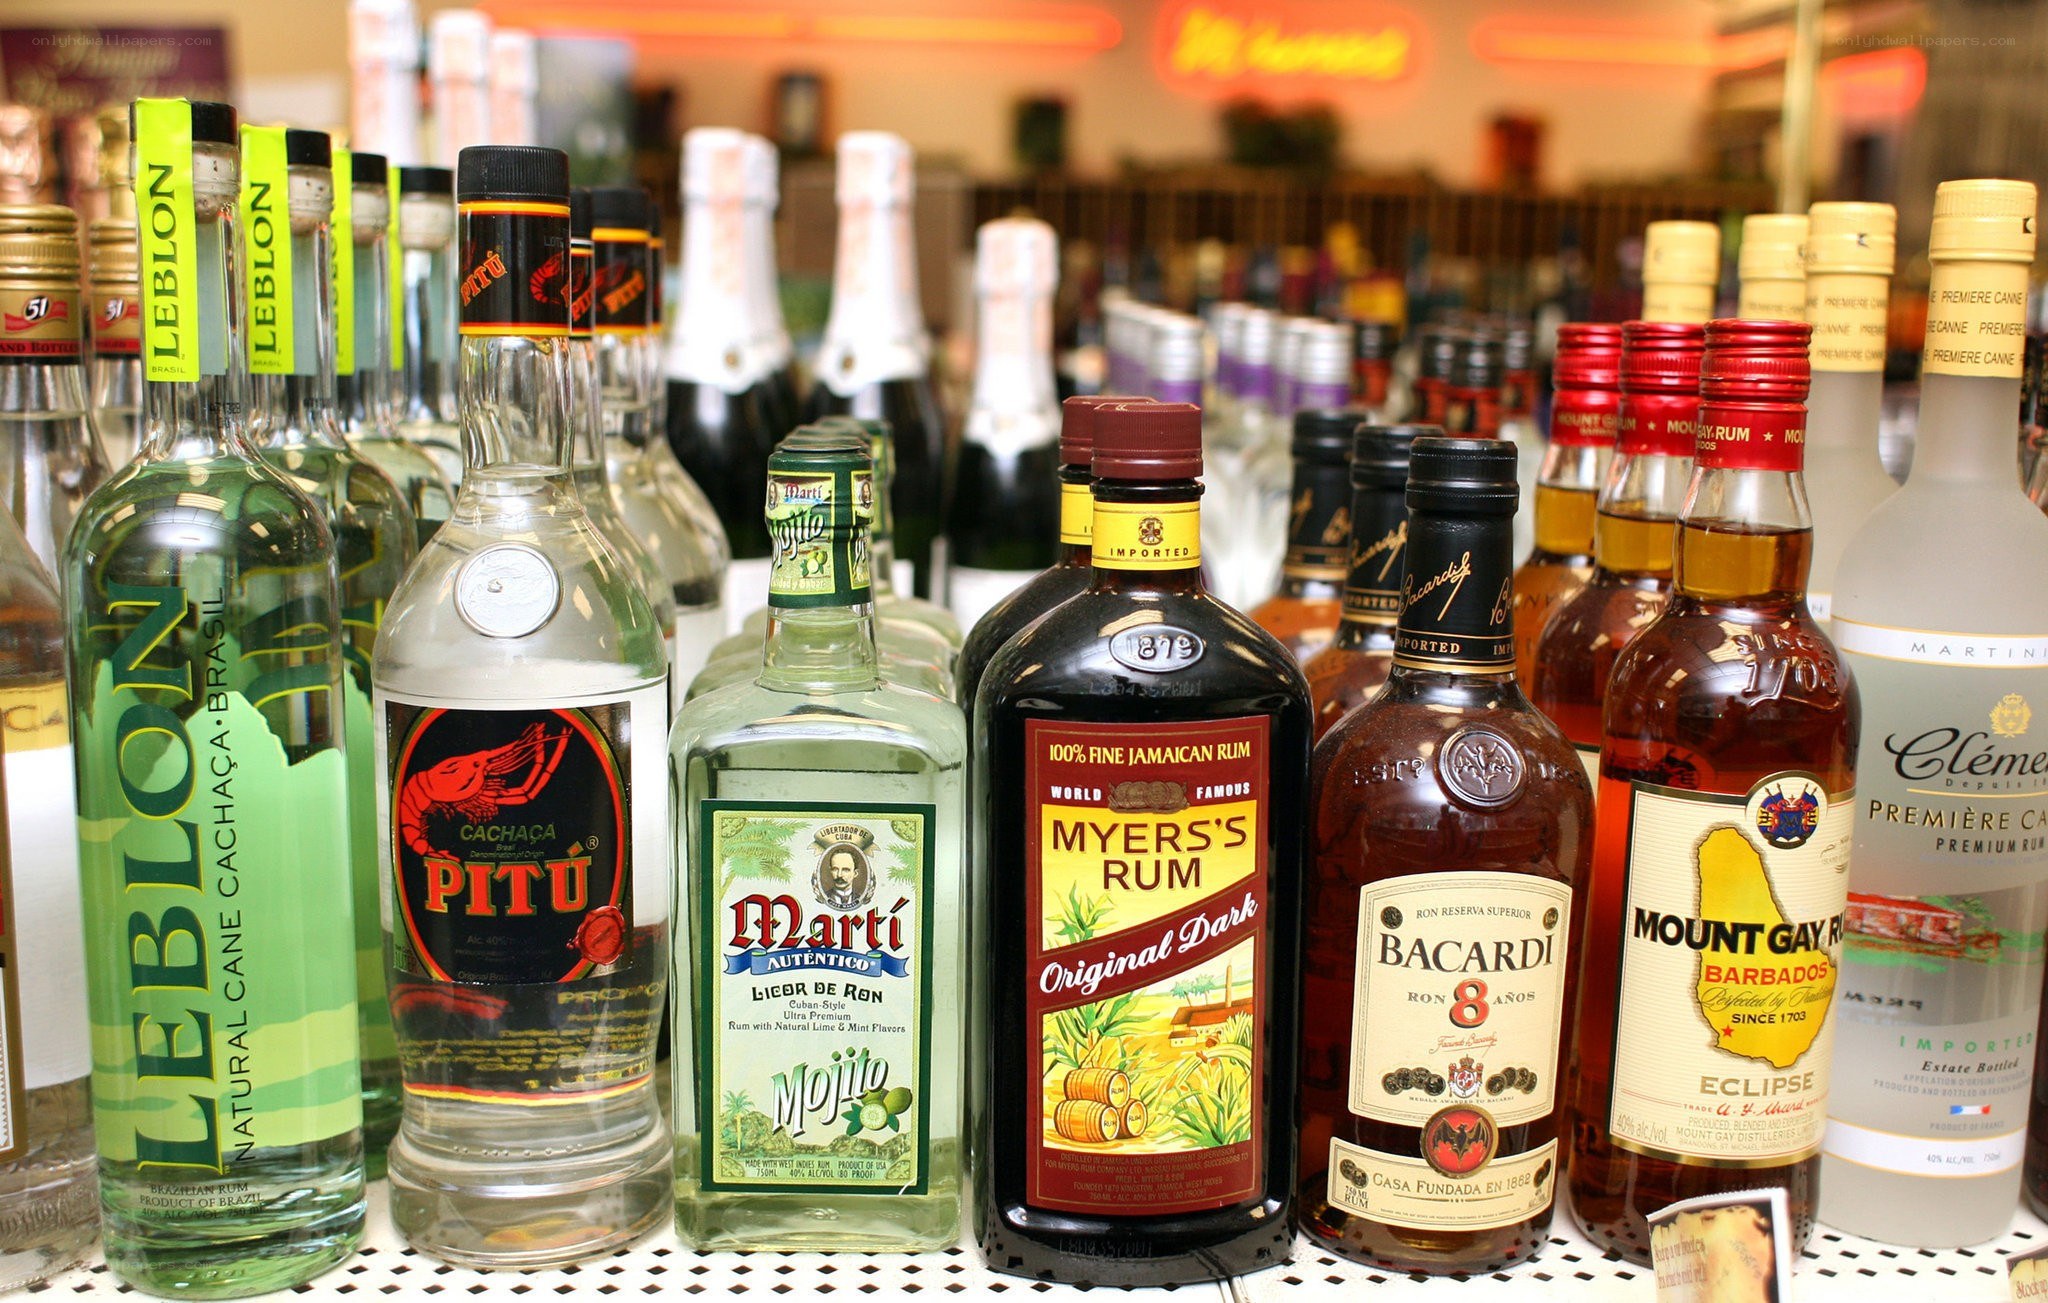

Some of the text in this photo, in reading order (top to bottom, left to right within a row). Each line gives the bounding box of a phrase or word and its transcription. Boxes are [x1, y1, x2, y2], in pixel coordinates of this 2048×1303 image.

[148, 163, 180, 360] LEBLON
[250, 182, 277, 355] LEBLON
[460, 250, 507, 306] PITÚ
[1941, 290, 1992, 304] PREMIERE
[1994, 291, 2023, 305] CANNE
[28, 297, 48, 320] 51
[106, 299, 123, 321] 51
[1937, 320, 1968, 334] CANNE
[1933, 349, 2015, 366] PREMIERE CANNE
[152, 365, 186, 374] BRASIL
[1715, 426, 1750, 442] RUM
[784, 481, 822, 499] Martí
[1110, 547, 1189, 558] IMPORTED
[1911, 643, 2048, 658] MARTINI
[1050, 741, 1251, 766] 100% FINE JAMAICAN RUM
[1884, 727, 2048, 780] Cléme
[1051, 782, 1251, 801] WORLD FAMOUS
[1869, 799, 2010, 831] PREMIÈRE
[459, 823, 557, 844] CACHAÇA
[820, 825, 869, 839] LIBERTADOR DE
[835, 833, 852, 841] CUBA
[1053, 816, 1248, 854] MYERS'S
[1936, 836, 2045, 853] PREMIUM RUM
[108, 578, 224, 1174] LEBLON
[423, 841, 593, 917] PITÚ
[1103, 857, 1202, 891] RUM
[729, 893, 910, 950] Martí
[1416, 906, 1532, 920] RON RESERVA SUPERIOR
[1633, 907, 1824, 955] MOUNT GAY
[1039, 892, 1259, 995] Original Dark
[1378, 932, 1555, 974] BACARDI
[219, 909, 247, 1001] CANE
[767, 950, 870, 972] AUTÉNTICO
[1704, 962, 1828, 986] BARBADOS
[752, 982, 883, 1003] LICOR DE RON
[1407, 978, 1536, 1028] RON 8 AÑOS
[1701, 986, 1787, 1013] Perfected by
[783, 1011, 851, 1021] Ultra Premium
[789, 1000, 846, 1011] Cuban-Style
[728, 1021, 906, 1033] Rum with Natural Lime & Mint Flavors
[1732, 1011, 1806, 1024] SINCE 1703
[1900, 1032, 2033, 1053] IMPORTED
[1922, 1057, 2020, 1074] Estate Bottled
[228, 1010, 256, 1162] NATURAL
[771, 1046, 889, 1138] Mojito
[1699, 1071, 1814, 1097] ECLIPSE
[1684, 1103, 1712, 1113] TRADE
[1616, 1114, 1634, 1136] 40%
[1676, 1126, 1795, 1142] MOUNT GAY DISTILLERIES
[1734, 1117, 1767, 1131] BLENDED
[745, 1159, 887, 1170] MADE WITH WEST INDIES RUM PRODUCT OF USA
[757, 1168, 778, 1178] 750ML
[789, 1168, 805, 1178] 40%
[808, 1168, 834, 1178] ALC/VOL
[150, 1182, 249, 1196] BRAZILIAN RUM
[1373, 1172, 1531, 1197] CASA FUNDADA EN 1862
[139, 1192, 264, 1209] PRODUCT OF BRAZIL
[1344, 1195, 1369, 1210] RUM
